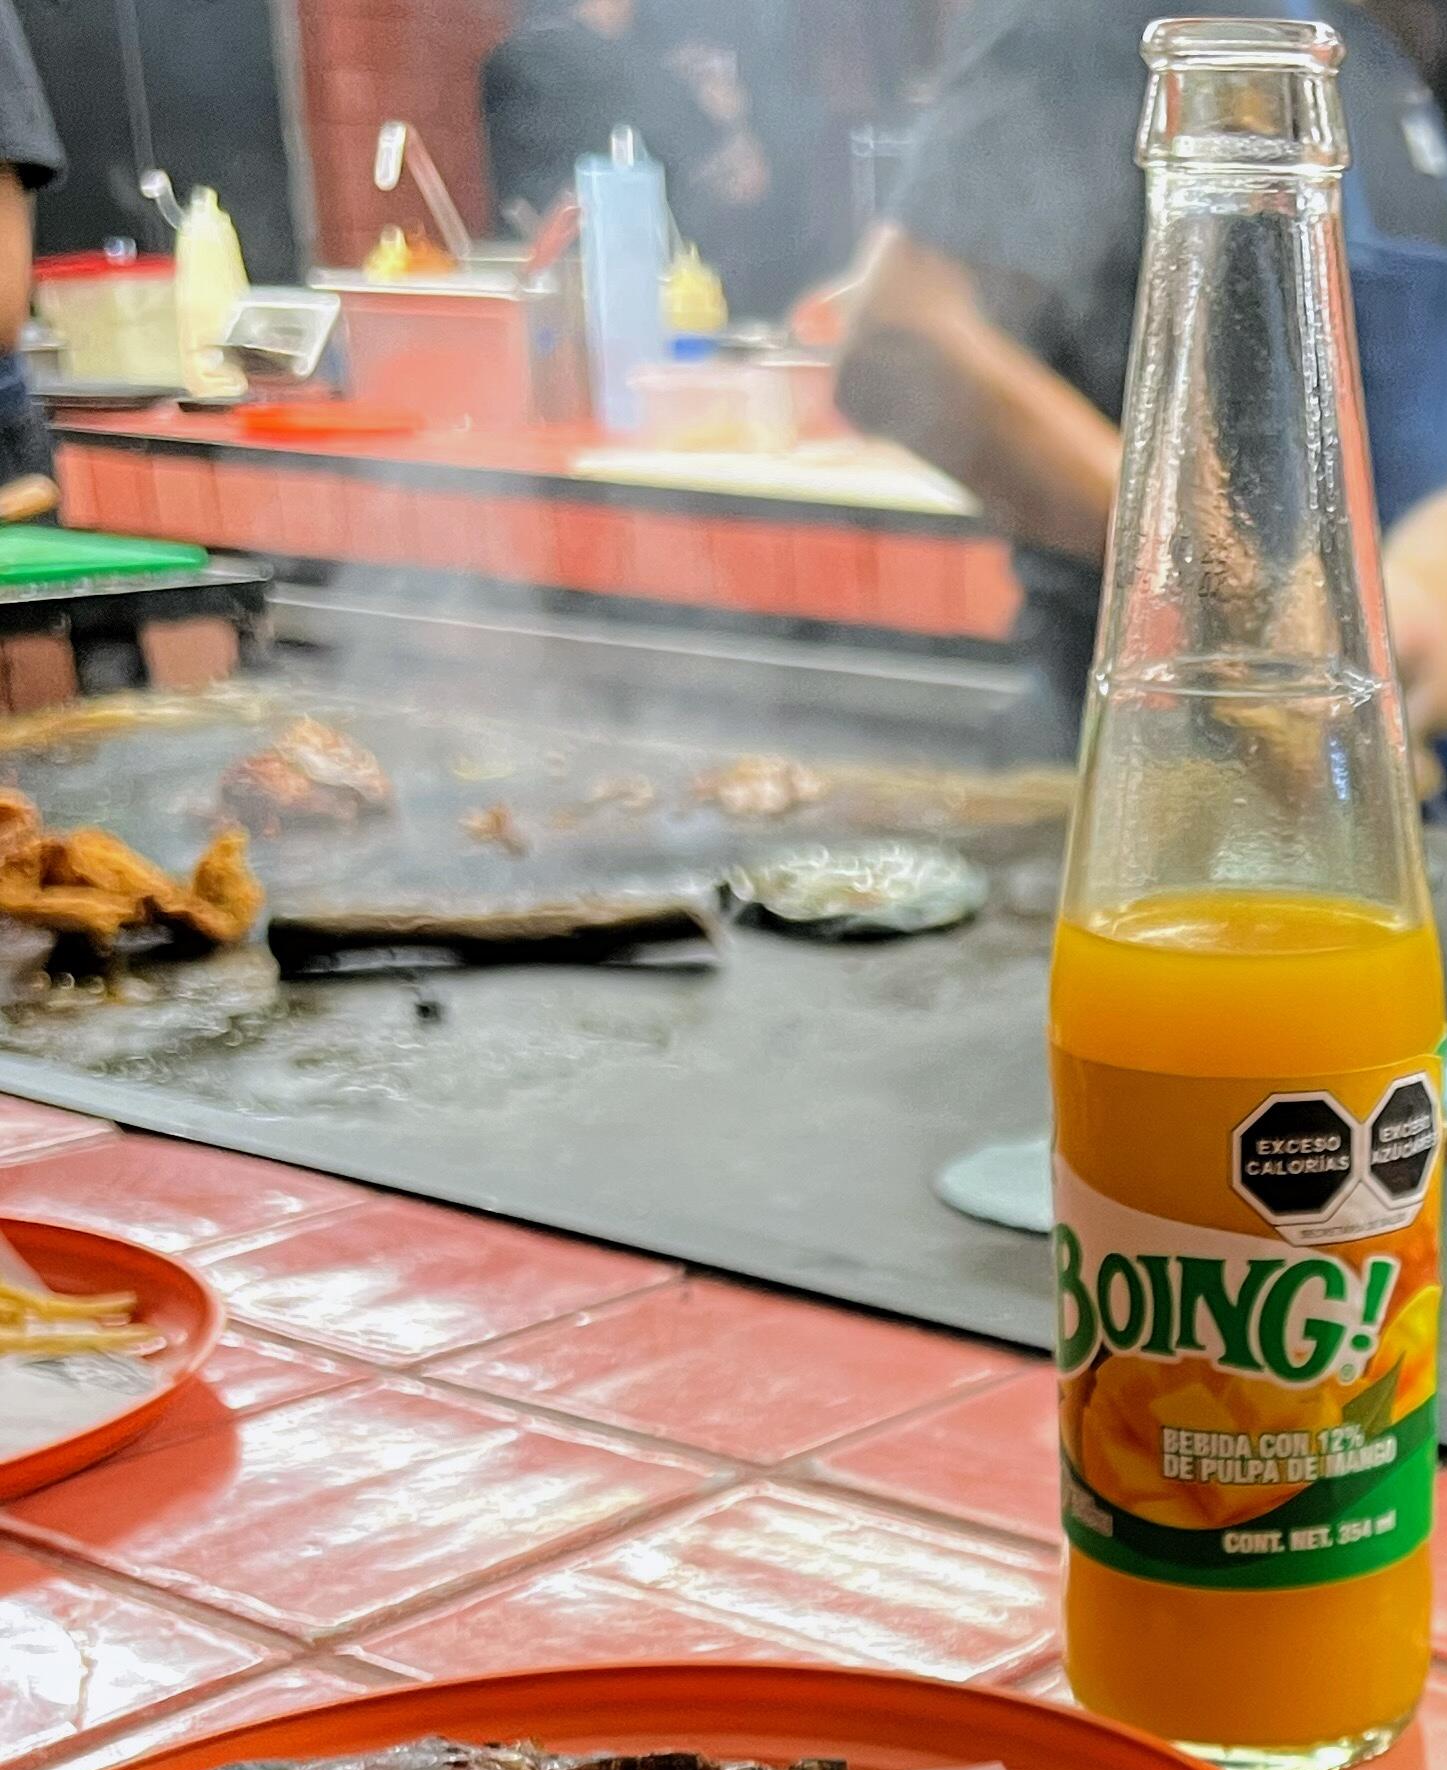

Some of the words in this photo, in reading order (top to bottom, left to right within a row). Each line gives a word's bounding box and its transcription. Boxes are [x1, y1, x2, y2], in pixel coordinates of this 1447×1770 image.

[1257, 1136, 1342, 1155] EXCESO
[1245, 1154, 1350, 1176] CALORÍAS
[1054, 1221, 1396, 1383] BOING!
[1162, 1427, 1250, 1458] BEBIDA
[1259, 1433, 1310, 1458] CON
[1317, 1423, 1365, 1455] 12%
[1162, 1454, 1194, 1480] DE
[1201, 1459, 1282, 1484] PULPA
[1287, 1456, 1318, 1481] DE
[1222, 1531, 1285, 1554] CONT.
[1290, 1527, 1334, 1551] NET.
